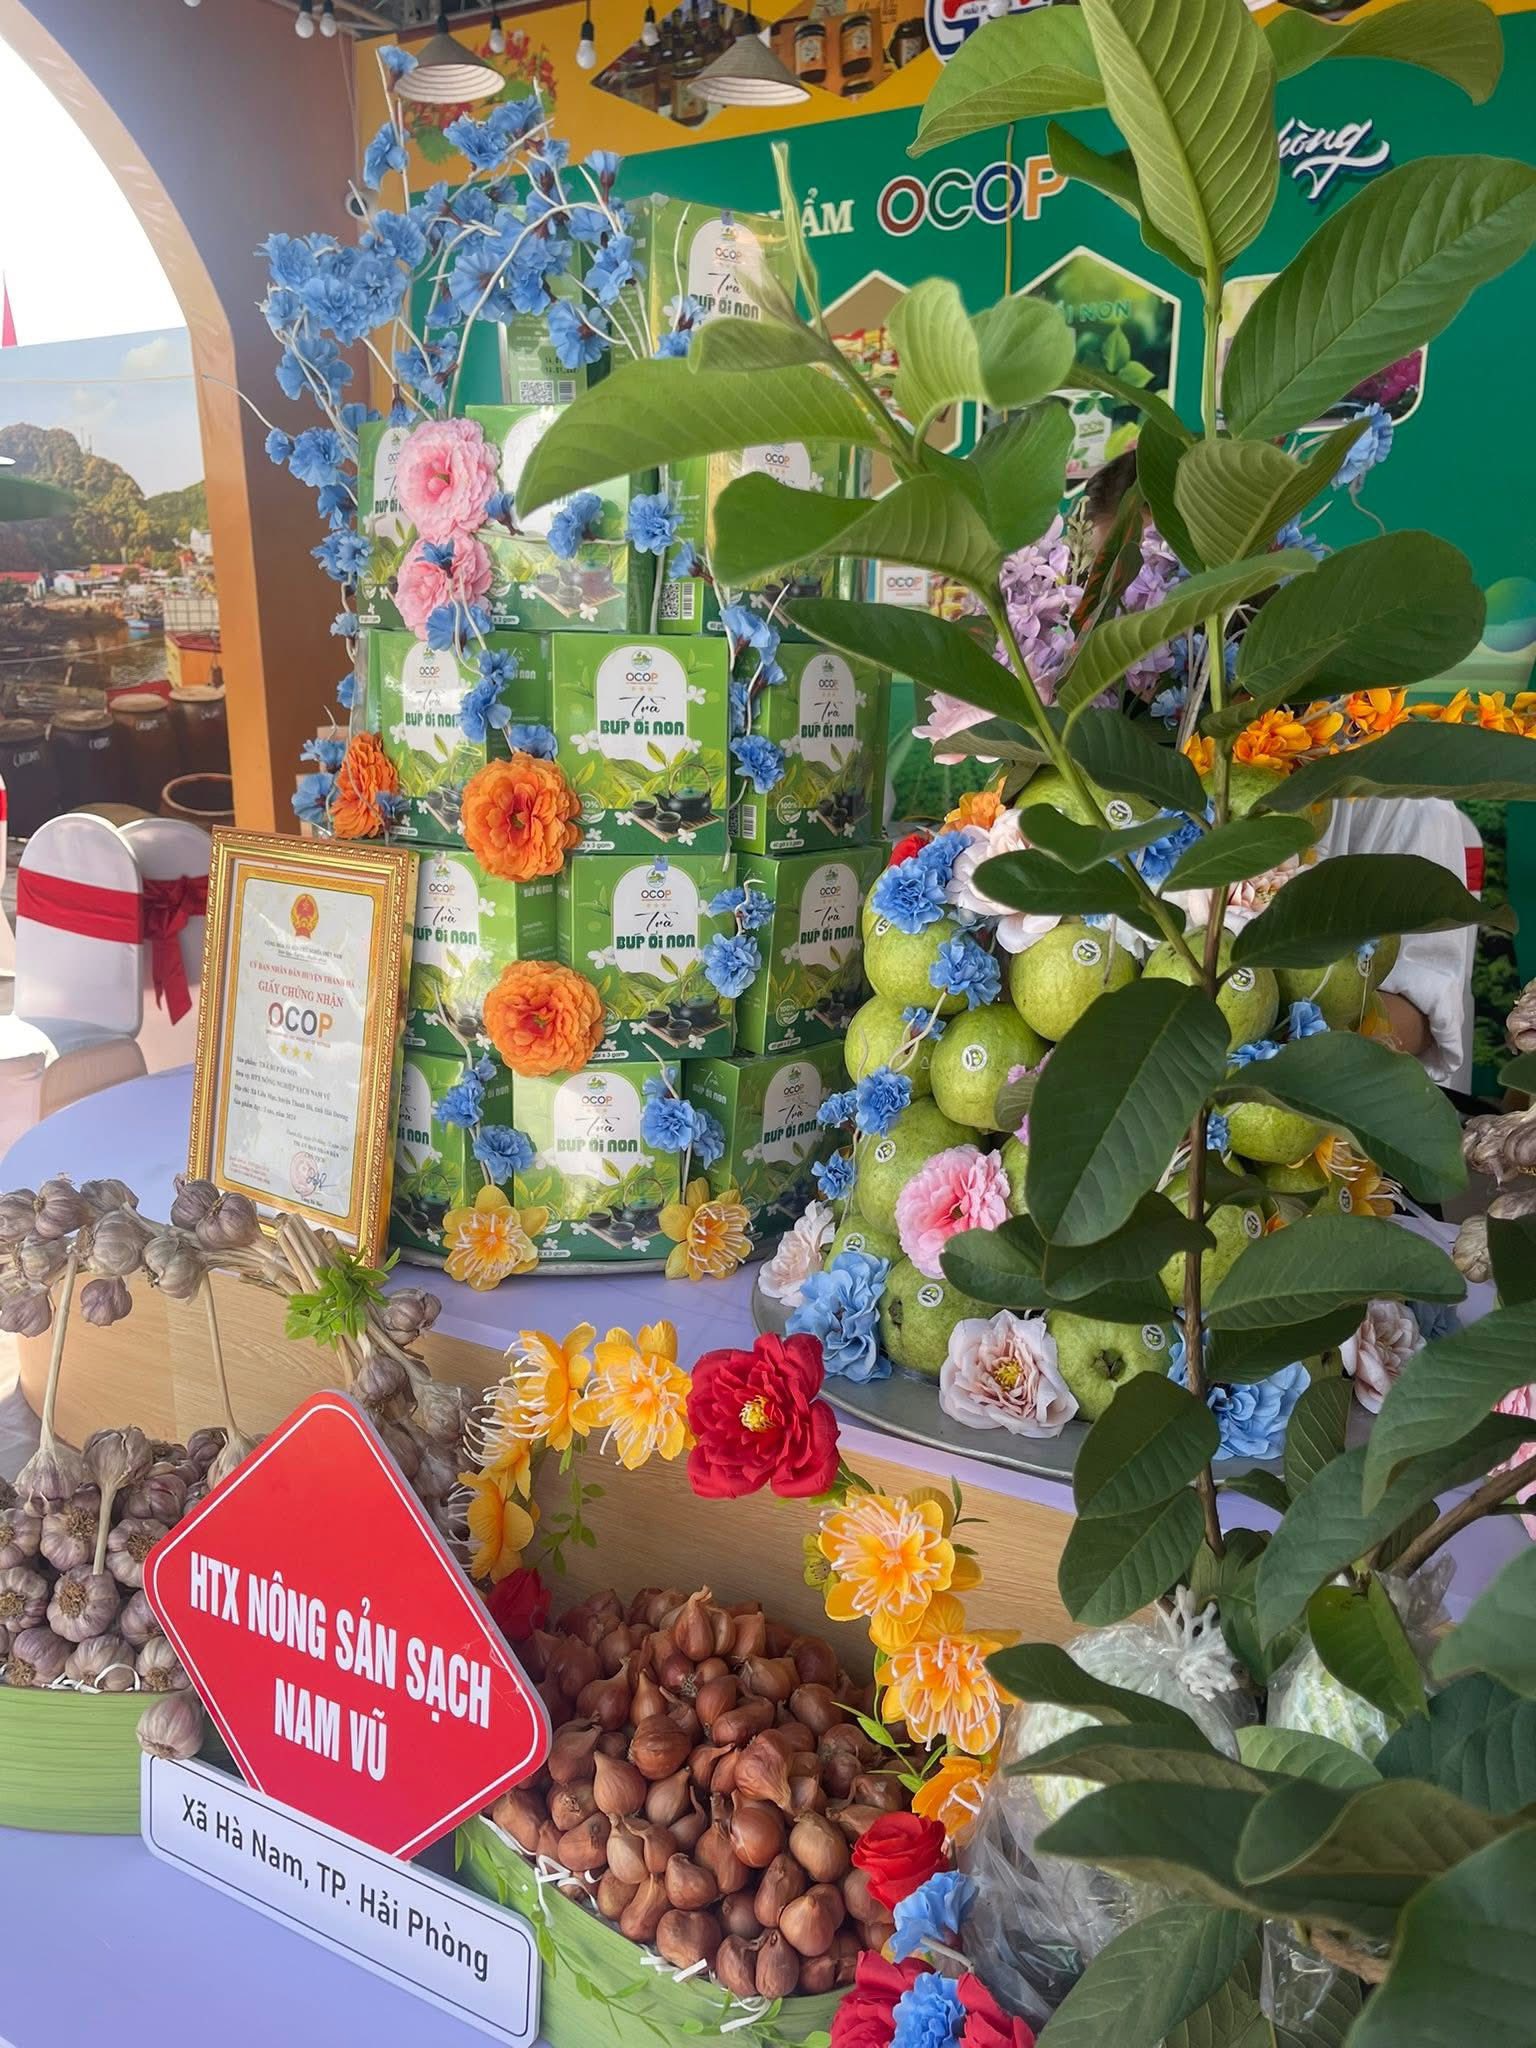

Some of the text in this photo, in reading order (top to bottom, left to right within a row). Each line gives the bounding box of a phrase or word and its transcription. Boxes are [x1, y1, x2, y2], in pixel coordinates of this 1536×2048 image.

[877, 154, 1068, 237] OCOP
[1079, 301, 1130, 322] NON
[765, 453, 790, 465] OCOP
[887, 576, 922, 588] OCOP
[420, 666, 440, 675] OCOP
[626, 672, 658, 682] OCOP
[619, 695, 666, 717] Trà
[814, 701, 843, 721] Trà
[429, 883, 455, 893] OCOP
[641, 890, 671, 899] OCOP
[820, 886, 841, 896] OCOP
[423, 905, 461, 926] Trà
[634, 911, 679, 932] Trà
[814, 906, 845, 926] Trà
[258, 978, 343, 1009] GIẤY CHỨNG NHẬN
[269, 1002, 333, 1038] OCOP
[784, 1084, 804, 1095] OCOP
[582, 1096, 612, 1105] OCOP
[778, 1104, 808, 1124] Trà
[190, 1551, 491, 1729] HTX NÔNG SẢN SẠCH
[274, 1677, 387, 1782] NAM VŨ
[182, 1794, 488, 1983] Xã Hà Nam, TP. Hải Phòng
